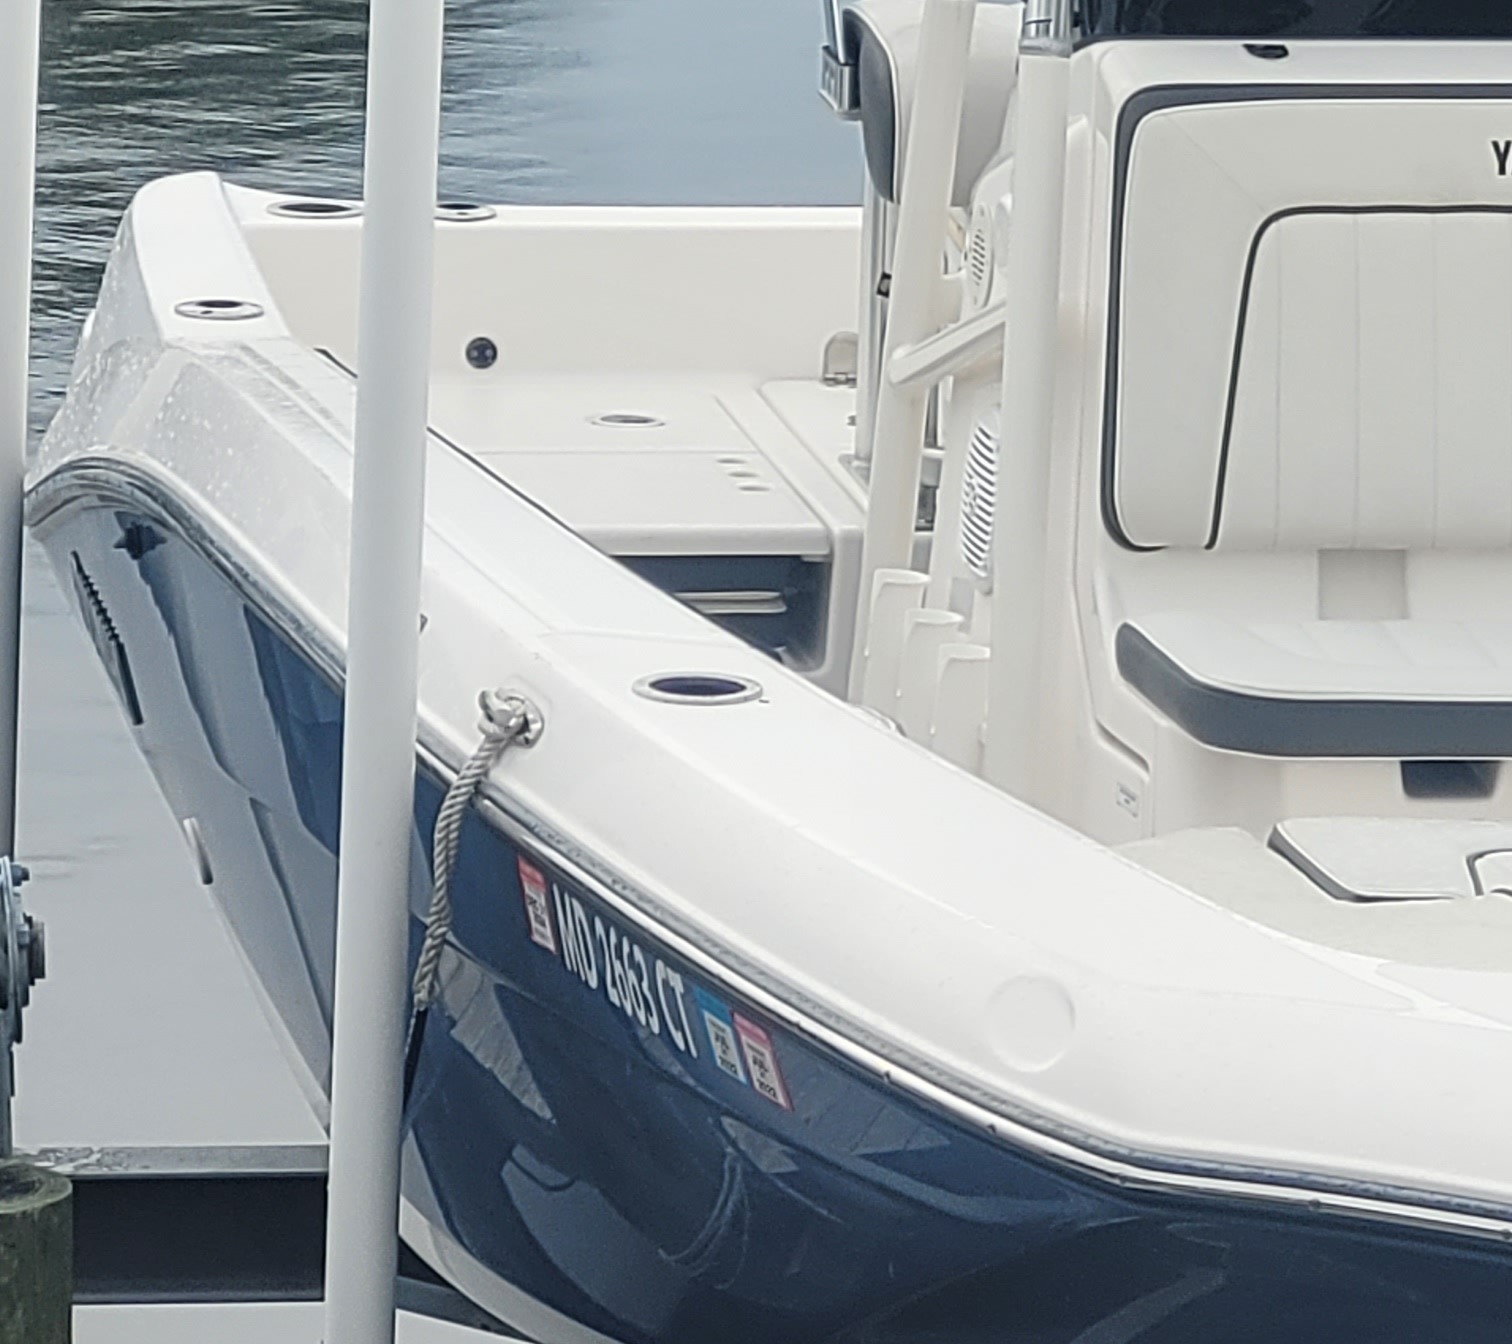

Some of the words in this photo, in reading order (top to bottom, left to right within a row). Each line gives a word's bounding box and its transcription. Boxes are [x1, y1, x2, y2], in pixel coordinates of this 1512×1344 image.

[552, 883, 599, 990] MD
[594, 915, 660, 1035] 2663
[655, 958, 698, 1059] CT
